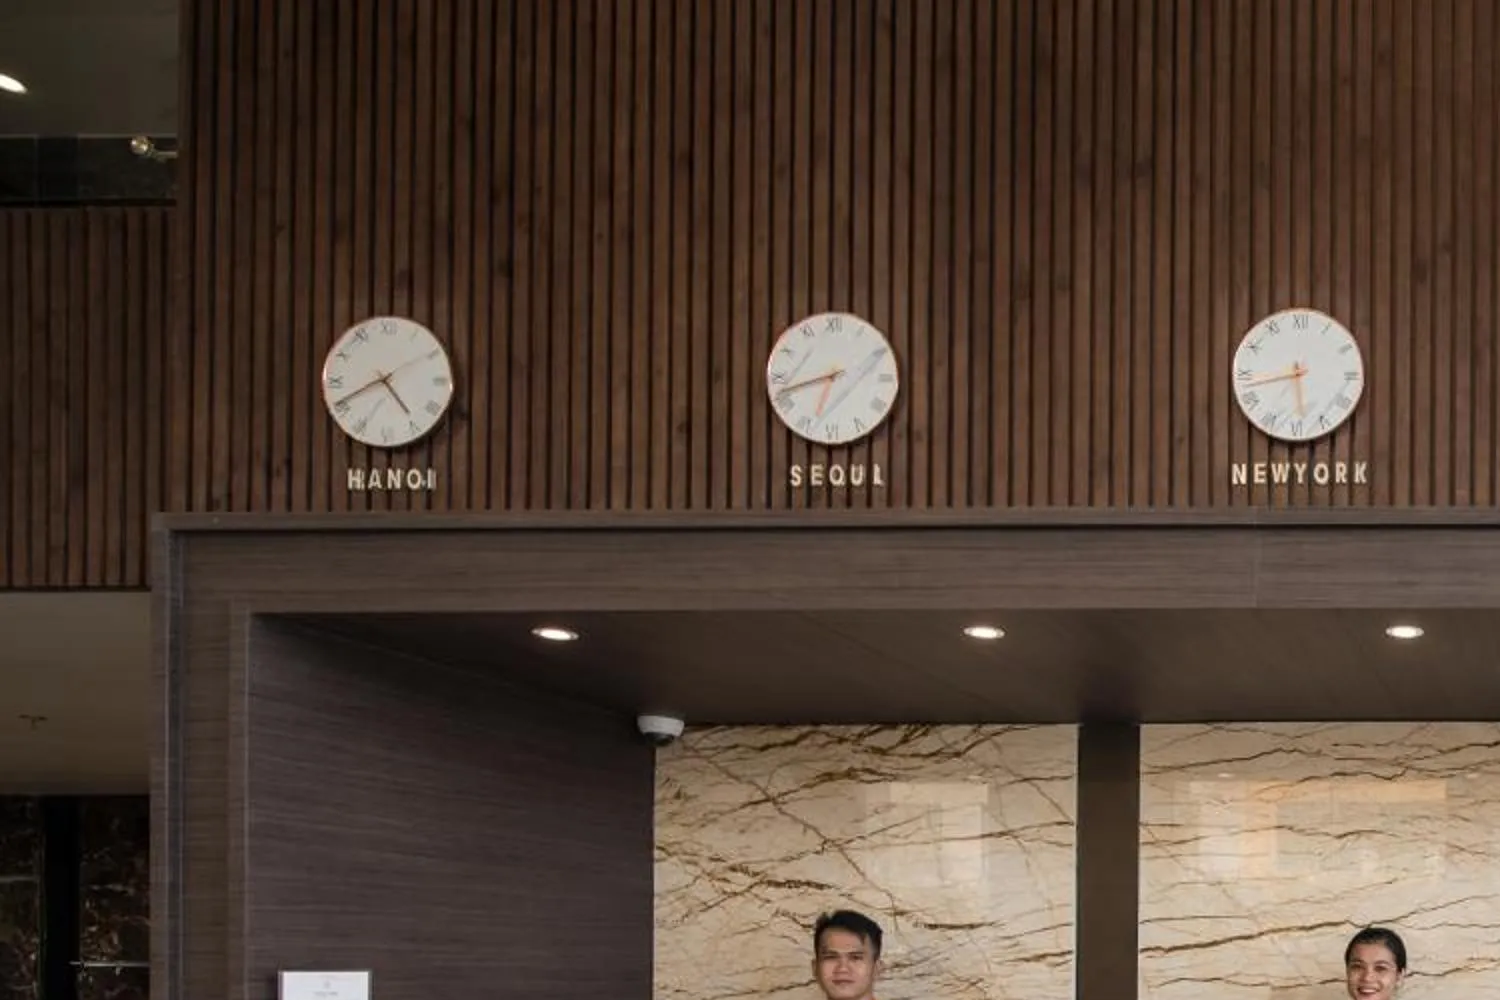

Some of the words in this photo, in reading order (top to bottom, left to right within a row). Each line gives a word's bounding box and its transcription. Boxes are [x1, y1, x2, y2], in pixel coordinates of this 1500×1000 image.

[347, 468, 436, 490] HANOI
[791, 463, 884, 487] SEOUL
[1231, 461, 1368, 485] NEWYORK
